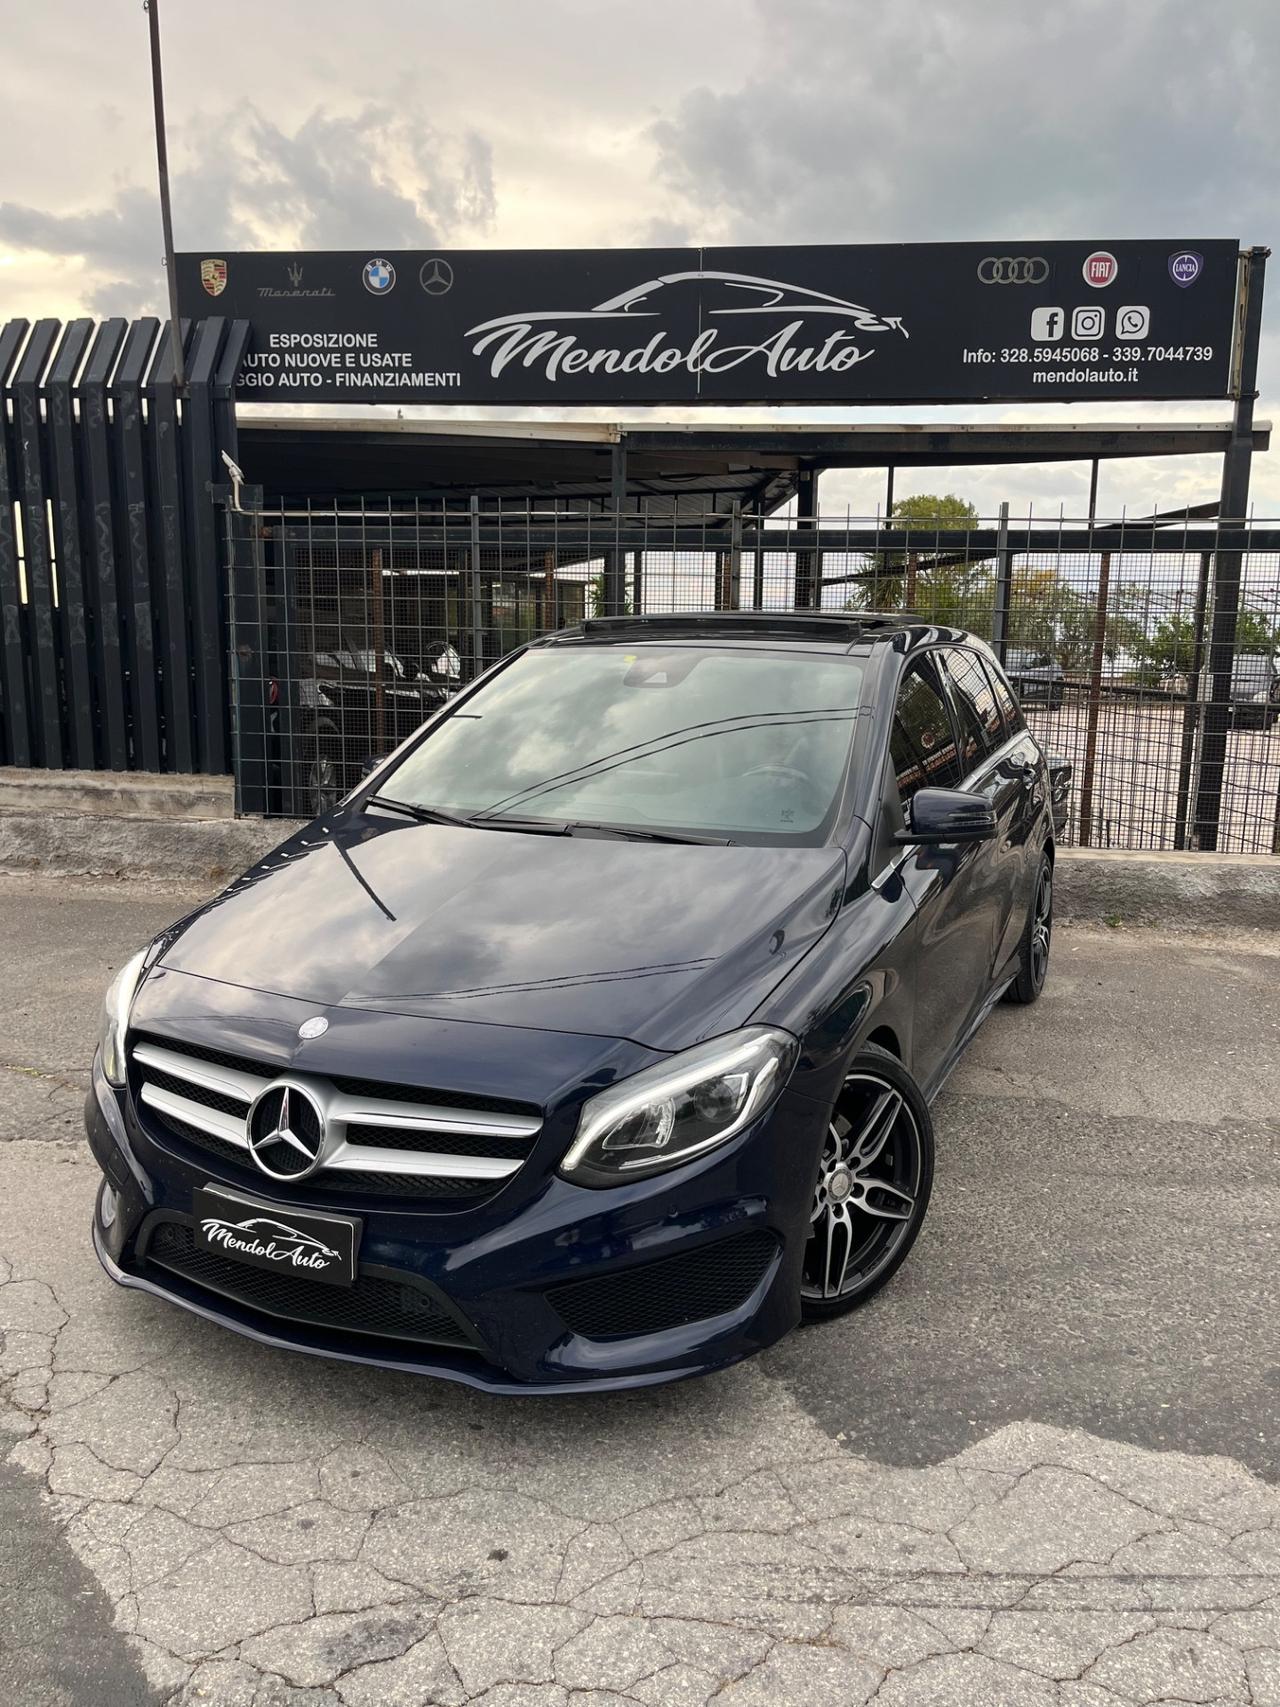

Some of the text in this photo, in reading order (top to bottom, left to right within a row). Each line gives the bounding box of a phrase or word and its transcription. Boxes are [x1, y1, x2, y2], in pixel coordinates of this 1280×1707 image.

[1091, 261, 1111, 278] FIAT
[1175, 263, 1196, 273] LANCIA
[269, 333, 378, 348] ESPOSIZIONE
[472, 320, 875, 382] MendolAuto
[963, 347, 996, 364] Info:
[1000, 347, 1100, 363] 328.5945068
[1112, 346, 1213, 362] 339.7044739
[284, 353, 342, 368] NUOVE
[345, 353, 356, 368] E
[359, 353, 413, 368] USATE
[278, 372, 323, 387] AUTO
[335, 372, 461, 387] FINANZIAMENTI
[1032, 367, 1139, 384] mendolauto.it
[202, 1222, 331, 1270] MendolAuto
